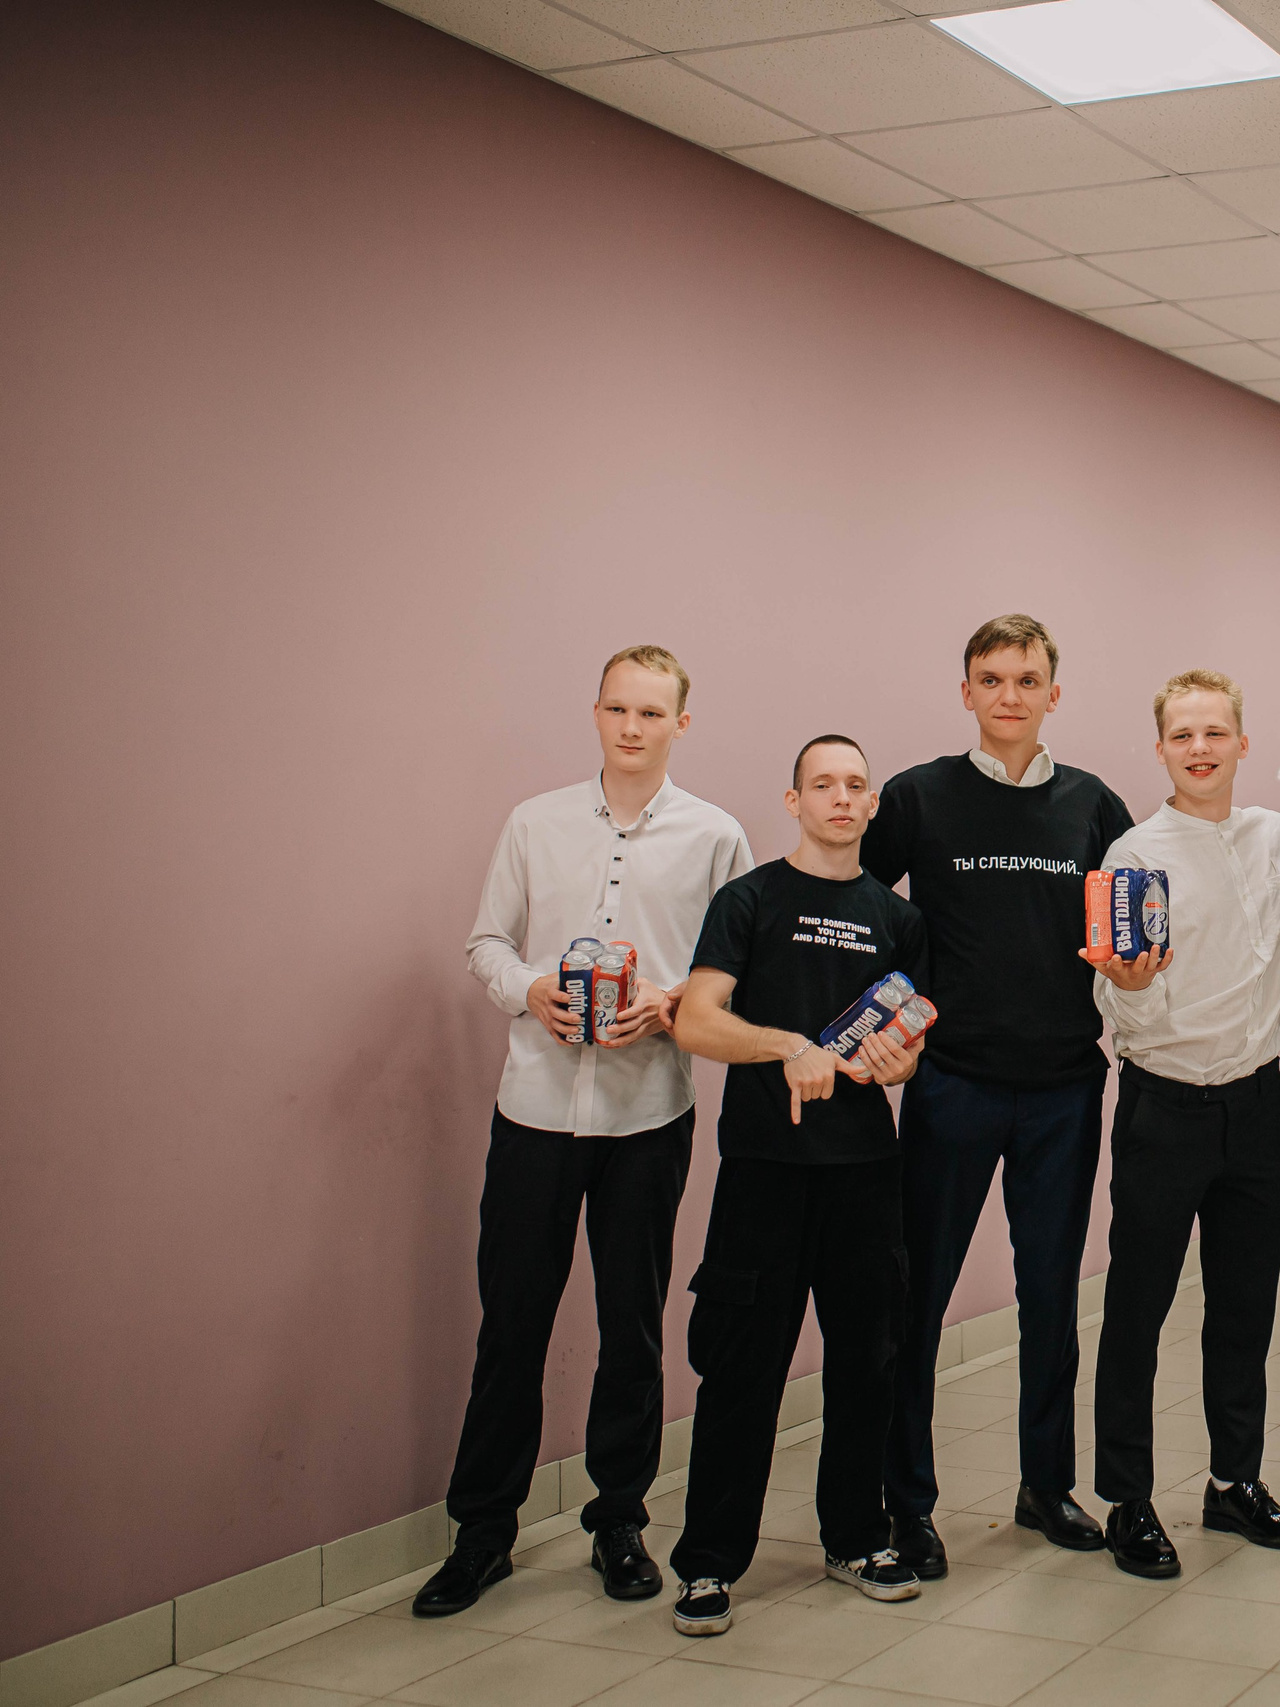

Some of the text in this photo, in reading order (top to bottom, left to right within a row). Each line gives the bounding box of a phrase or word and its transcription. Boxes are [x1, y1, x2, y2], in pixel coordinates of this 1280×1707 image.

[953, 857, 974, 871] ТЫ
[1115, 876, 1132, 952] ВЫГОДНО
[798, 916, 871, 935] FIND SOMETHING
[817, 926, 856, 941] YOU LIKE
[792, 933, 877, 953] AND DO IT FOREVER
